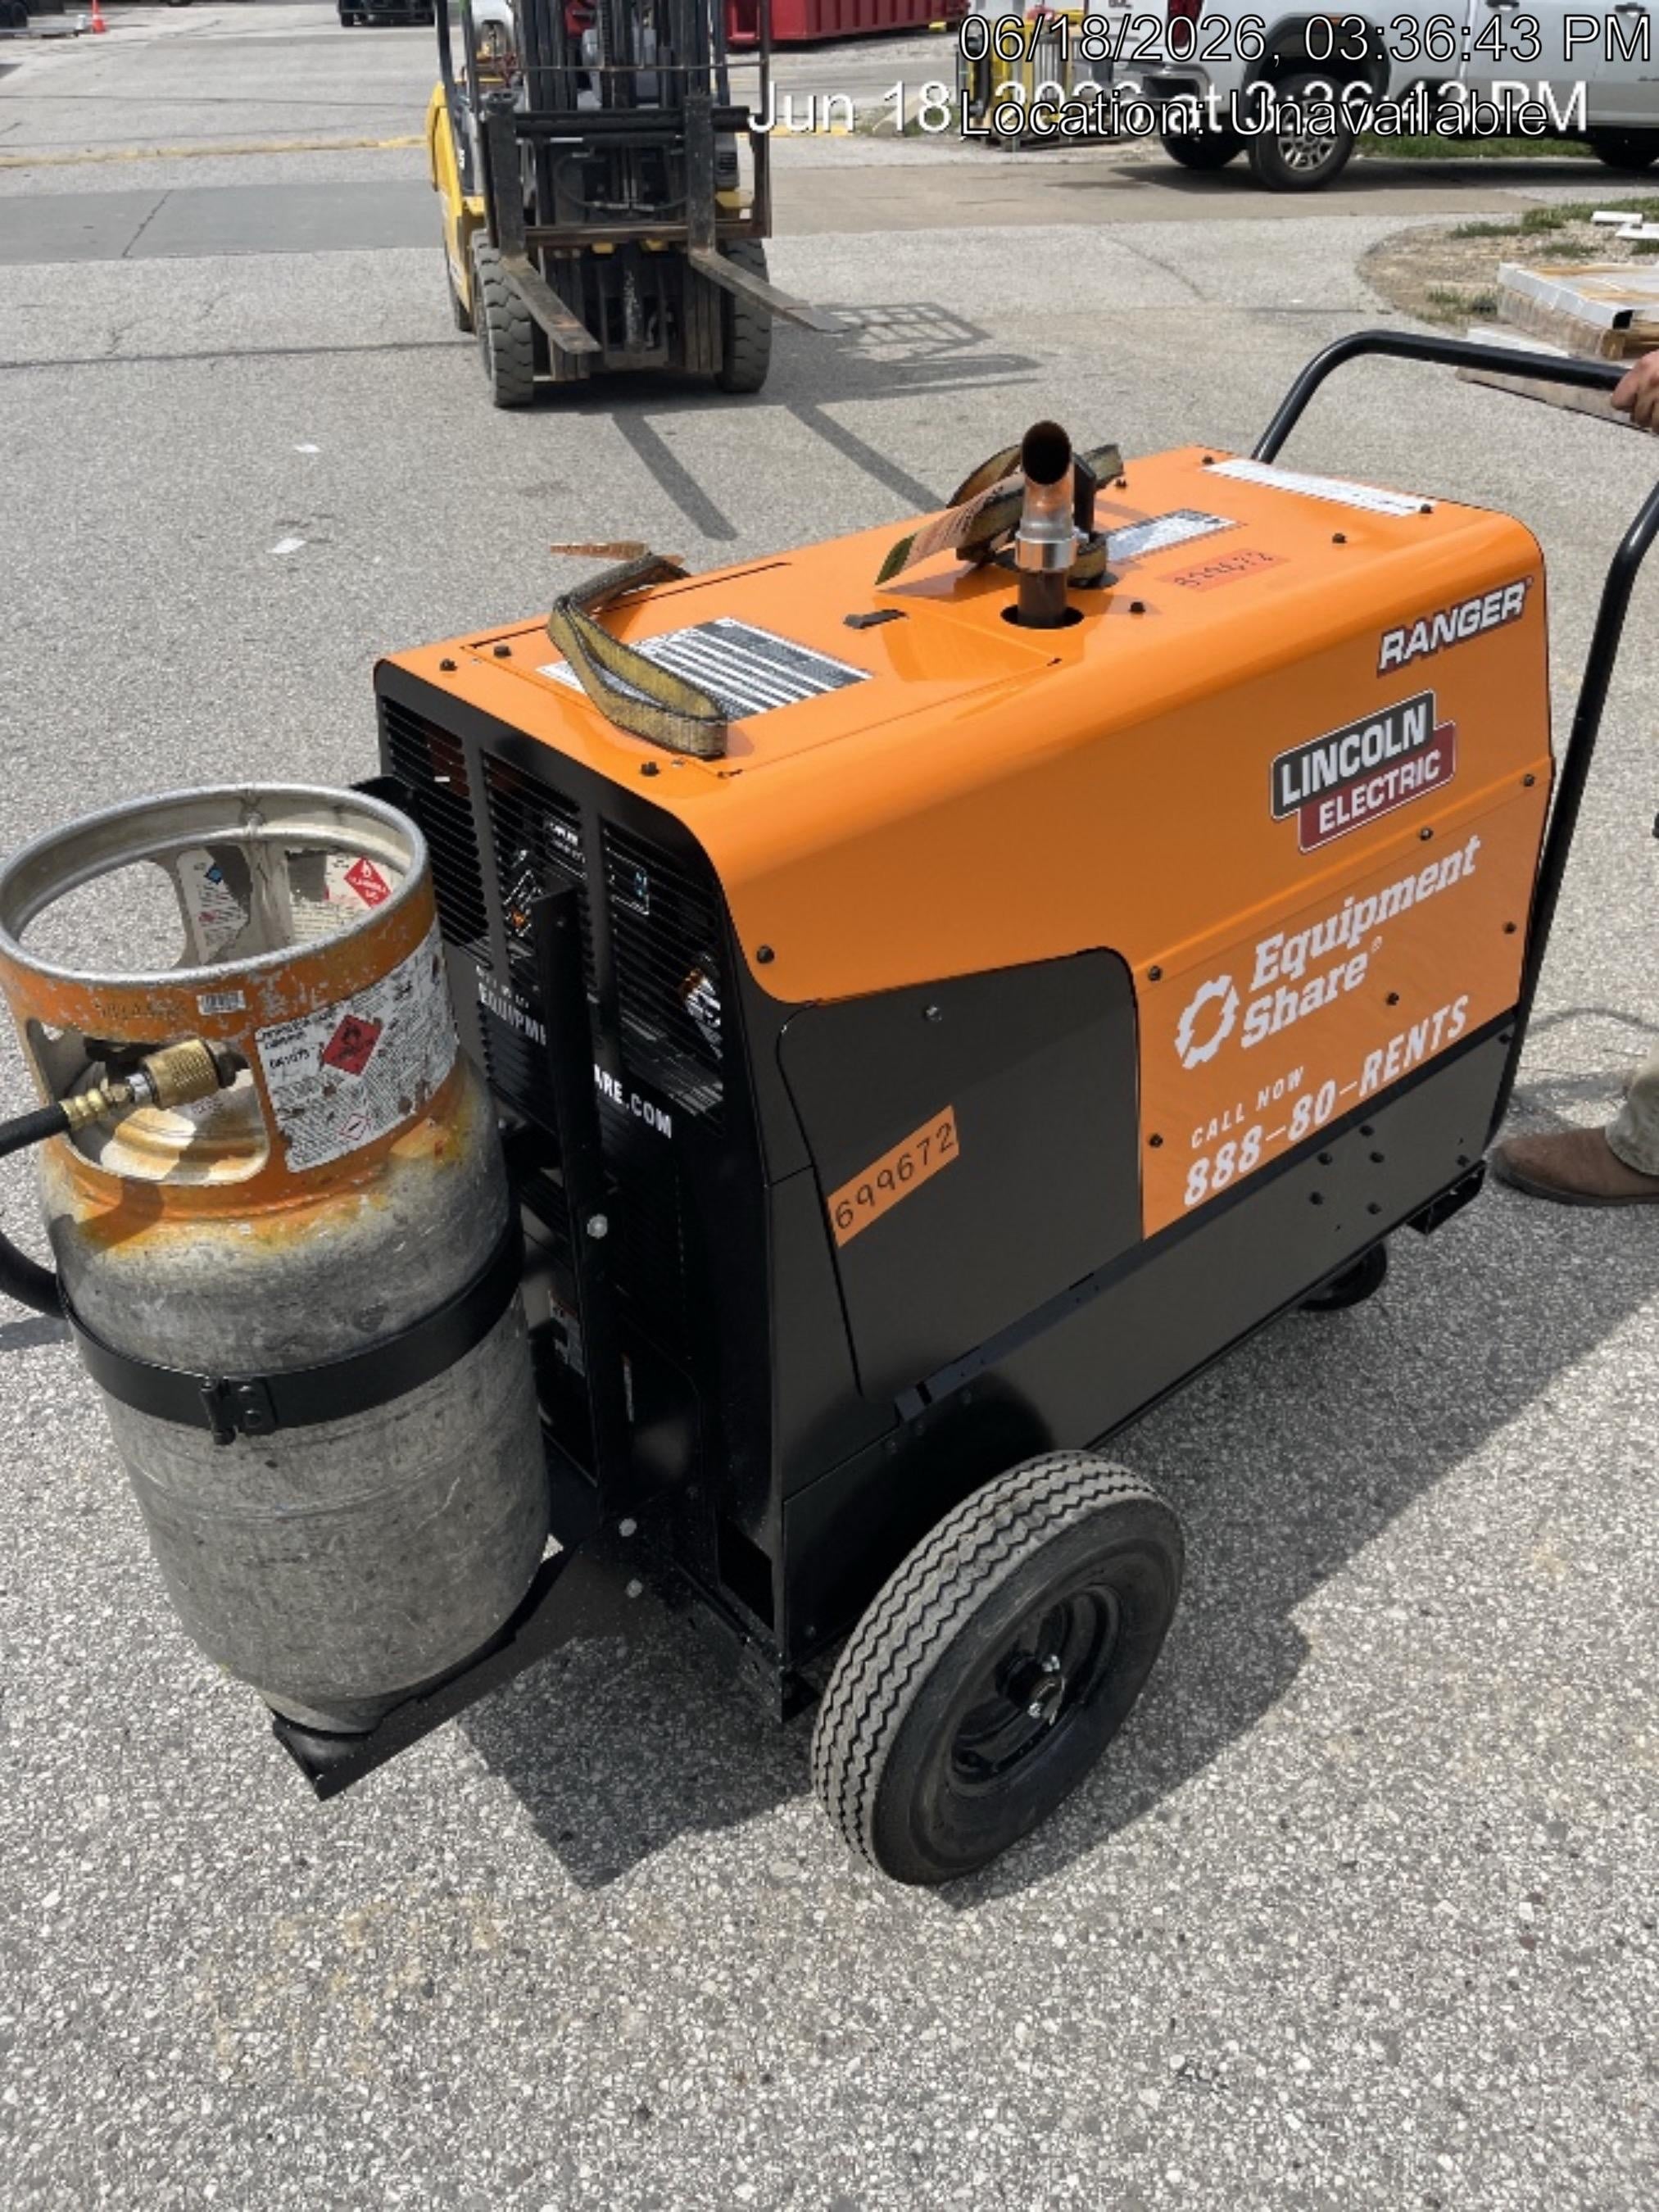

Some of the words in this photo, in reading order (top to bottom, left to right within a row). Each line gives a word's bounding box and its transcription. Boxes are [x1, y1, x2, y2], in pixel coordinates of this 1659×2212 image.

[1377, 580, 1527, 672] RANGER
[1281, 702, 1427, 807] LINCOLN
[1318, 749, 1441, 835] ELECTRIC
[1249, 834, 1481, 993] Equipment
[1240, 952, 1369, 1049] Share
[1183, 994, 1470, 1207] 888-80-RENTS
[1190, 1102, 1245, 1149] CALL
[1255, 1066, 1304, 1112] NOW
[835, 1122, 954, 1230] 699672
